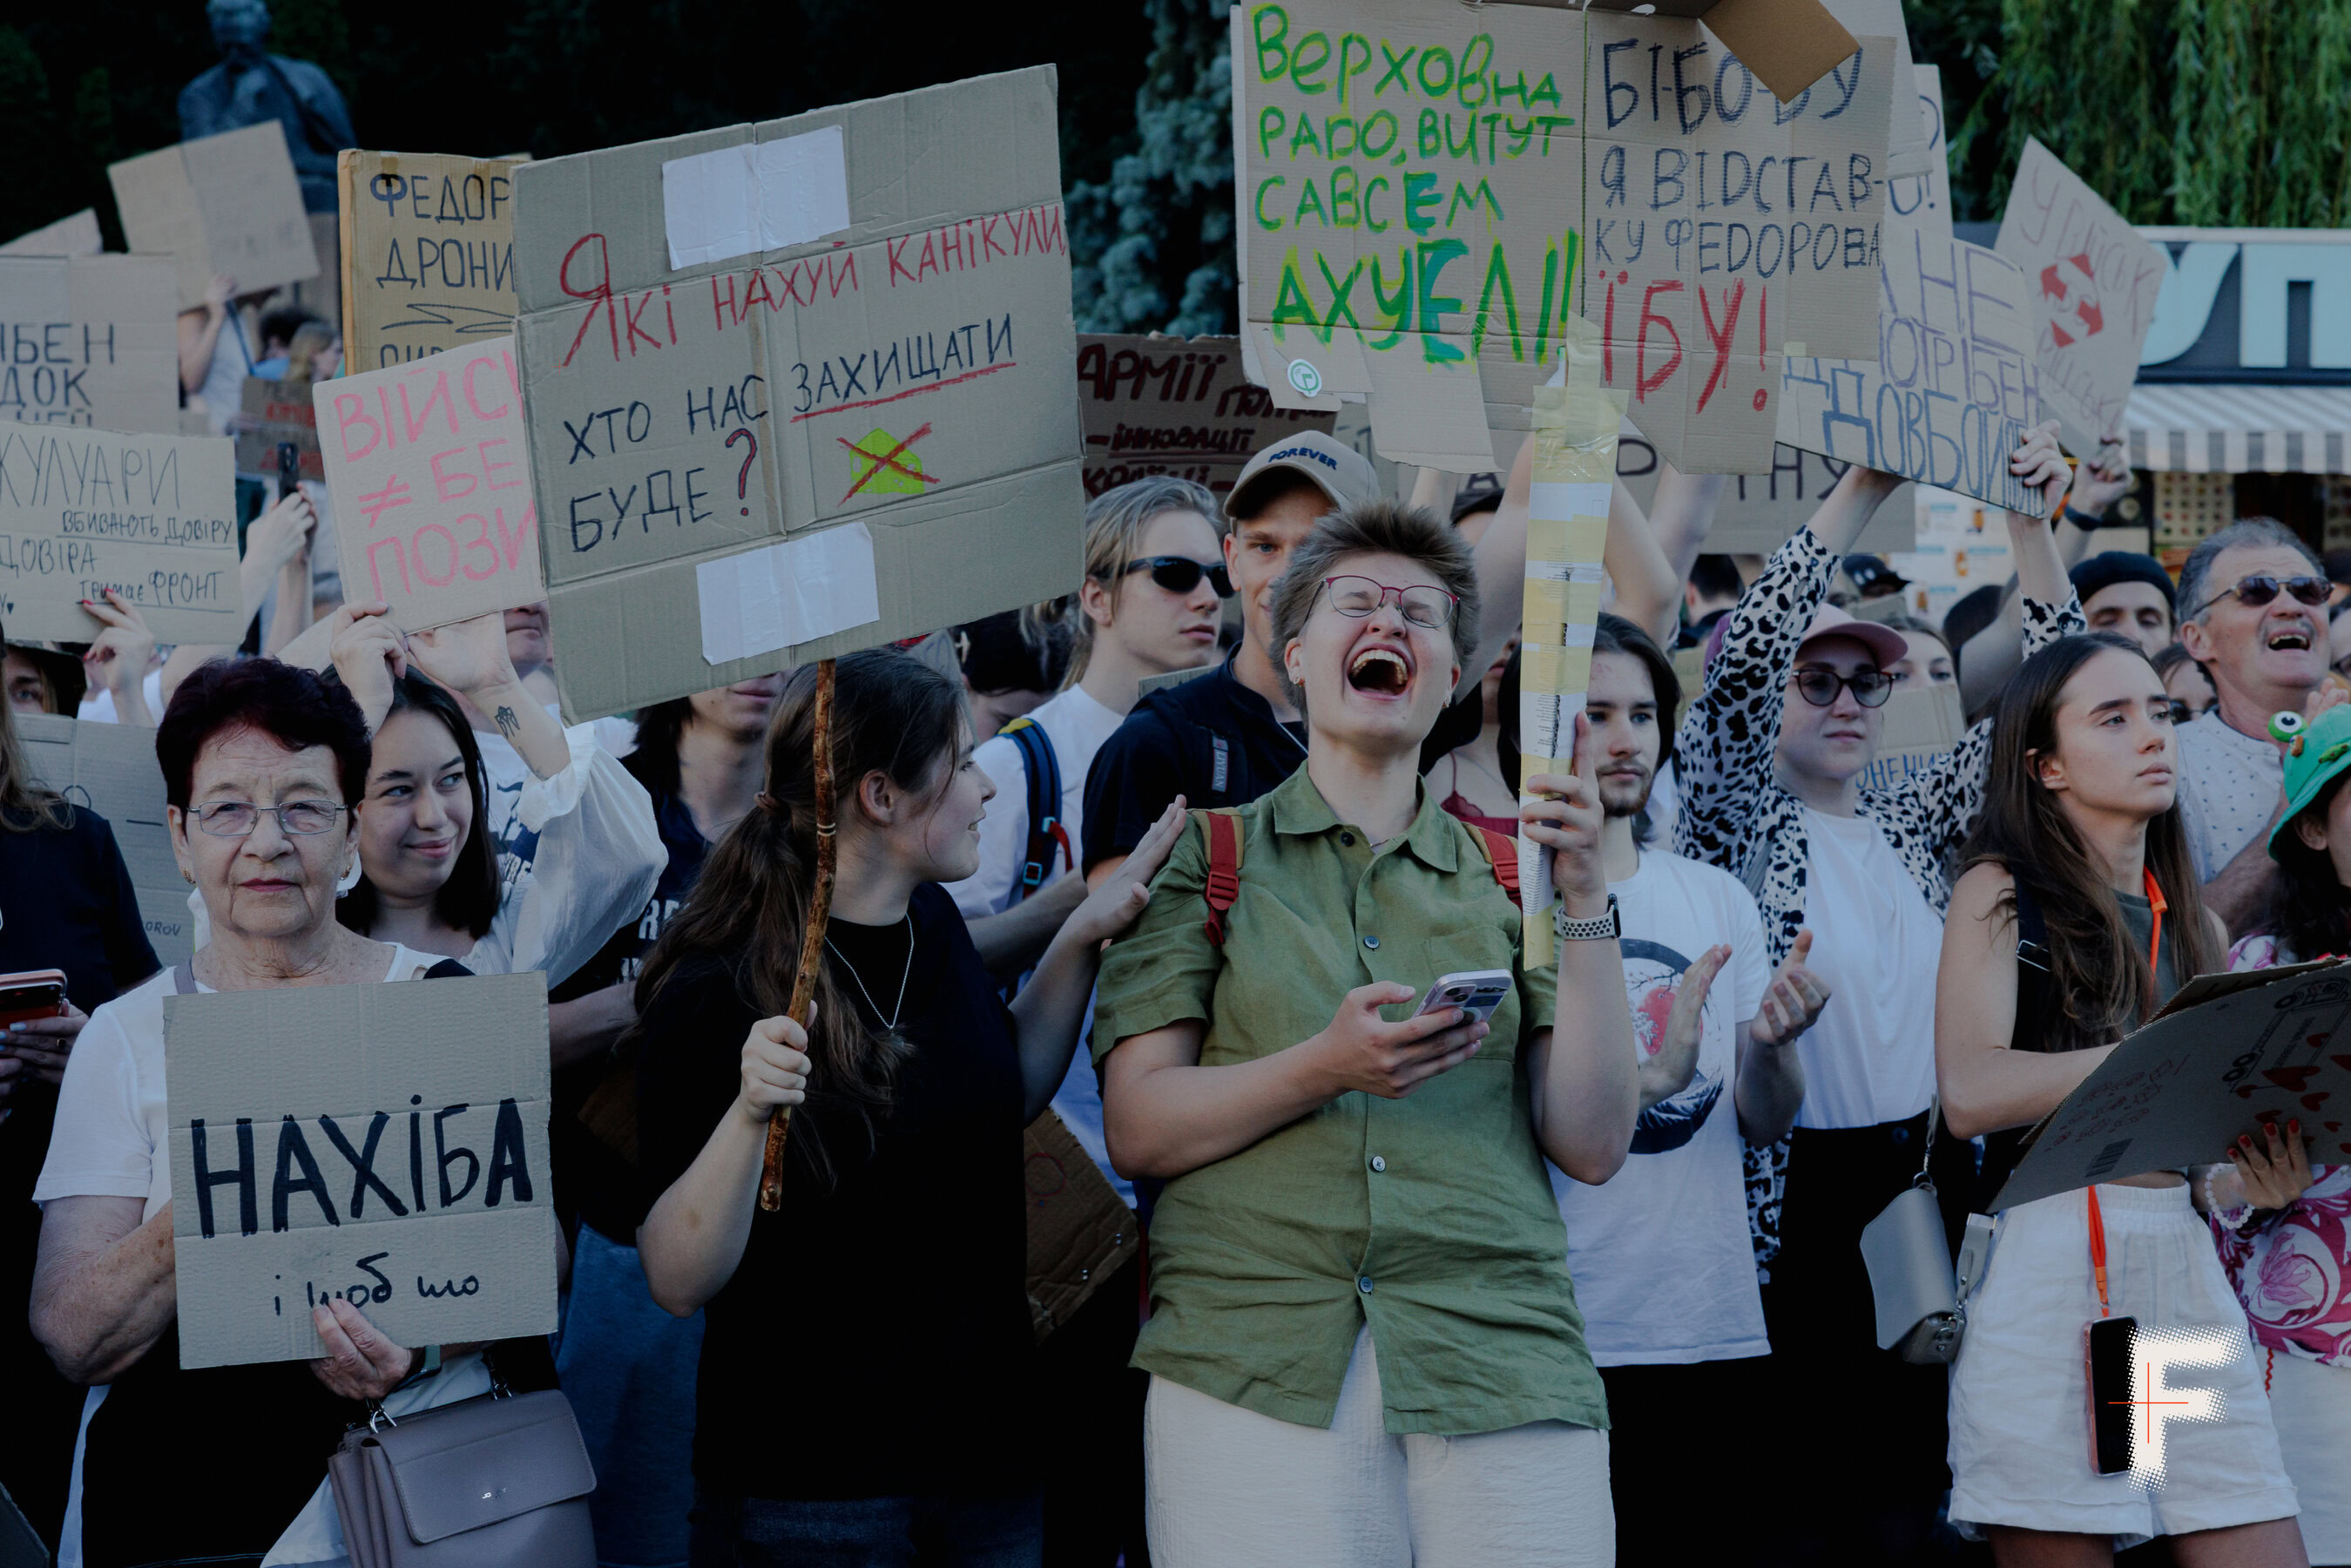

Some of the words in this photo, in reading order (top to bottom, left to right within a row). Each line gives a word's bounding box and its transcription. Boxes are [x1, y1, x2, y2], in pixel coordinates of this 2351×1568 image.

[370, 173, 510, 226] ФЕДОР
[1254, 166, 1504, 236] САВСЕМ
[1600, 145, 1626, 209] Я
[375, 237, 517, 293] ДРОНИ
[1596, 217, 1645, 265] КУ
[559, 233, 677, 367] ЯКІ
[712, 240, 858, 332] НАХУЙ
[1598, 270, 1768, 415] ЇБУ!
[563, 400, 651, 464] ХТО
[688, 375, 768, 436] НАС
[790, 313, 1014, 412] ЗАХИЩАТИ
[1268, 447, 1337, 470] FOREVER
[62, 510, 159, 537] ВБИВАЮТЬ
[165, 513, 233, 547] ДОВІРУ
[148, 570, 225, 608] ФРОНТ
[192, 1094, 534, 1239] НАХІБА
[274, 1274, 282, 1316] і
